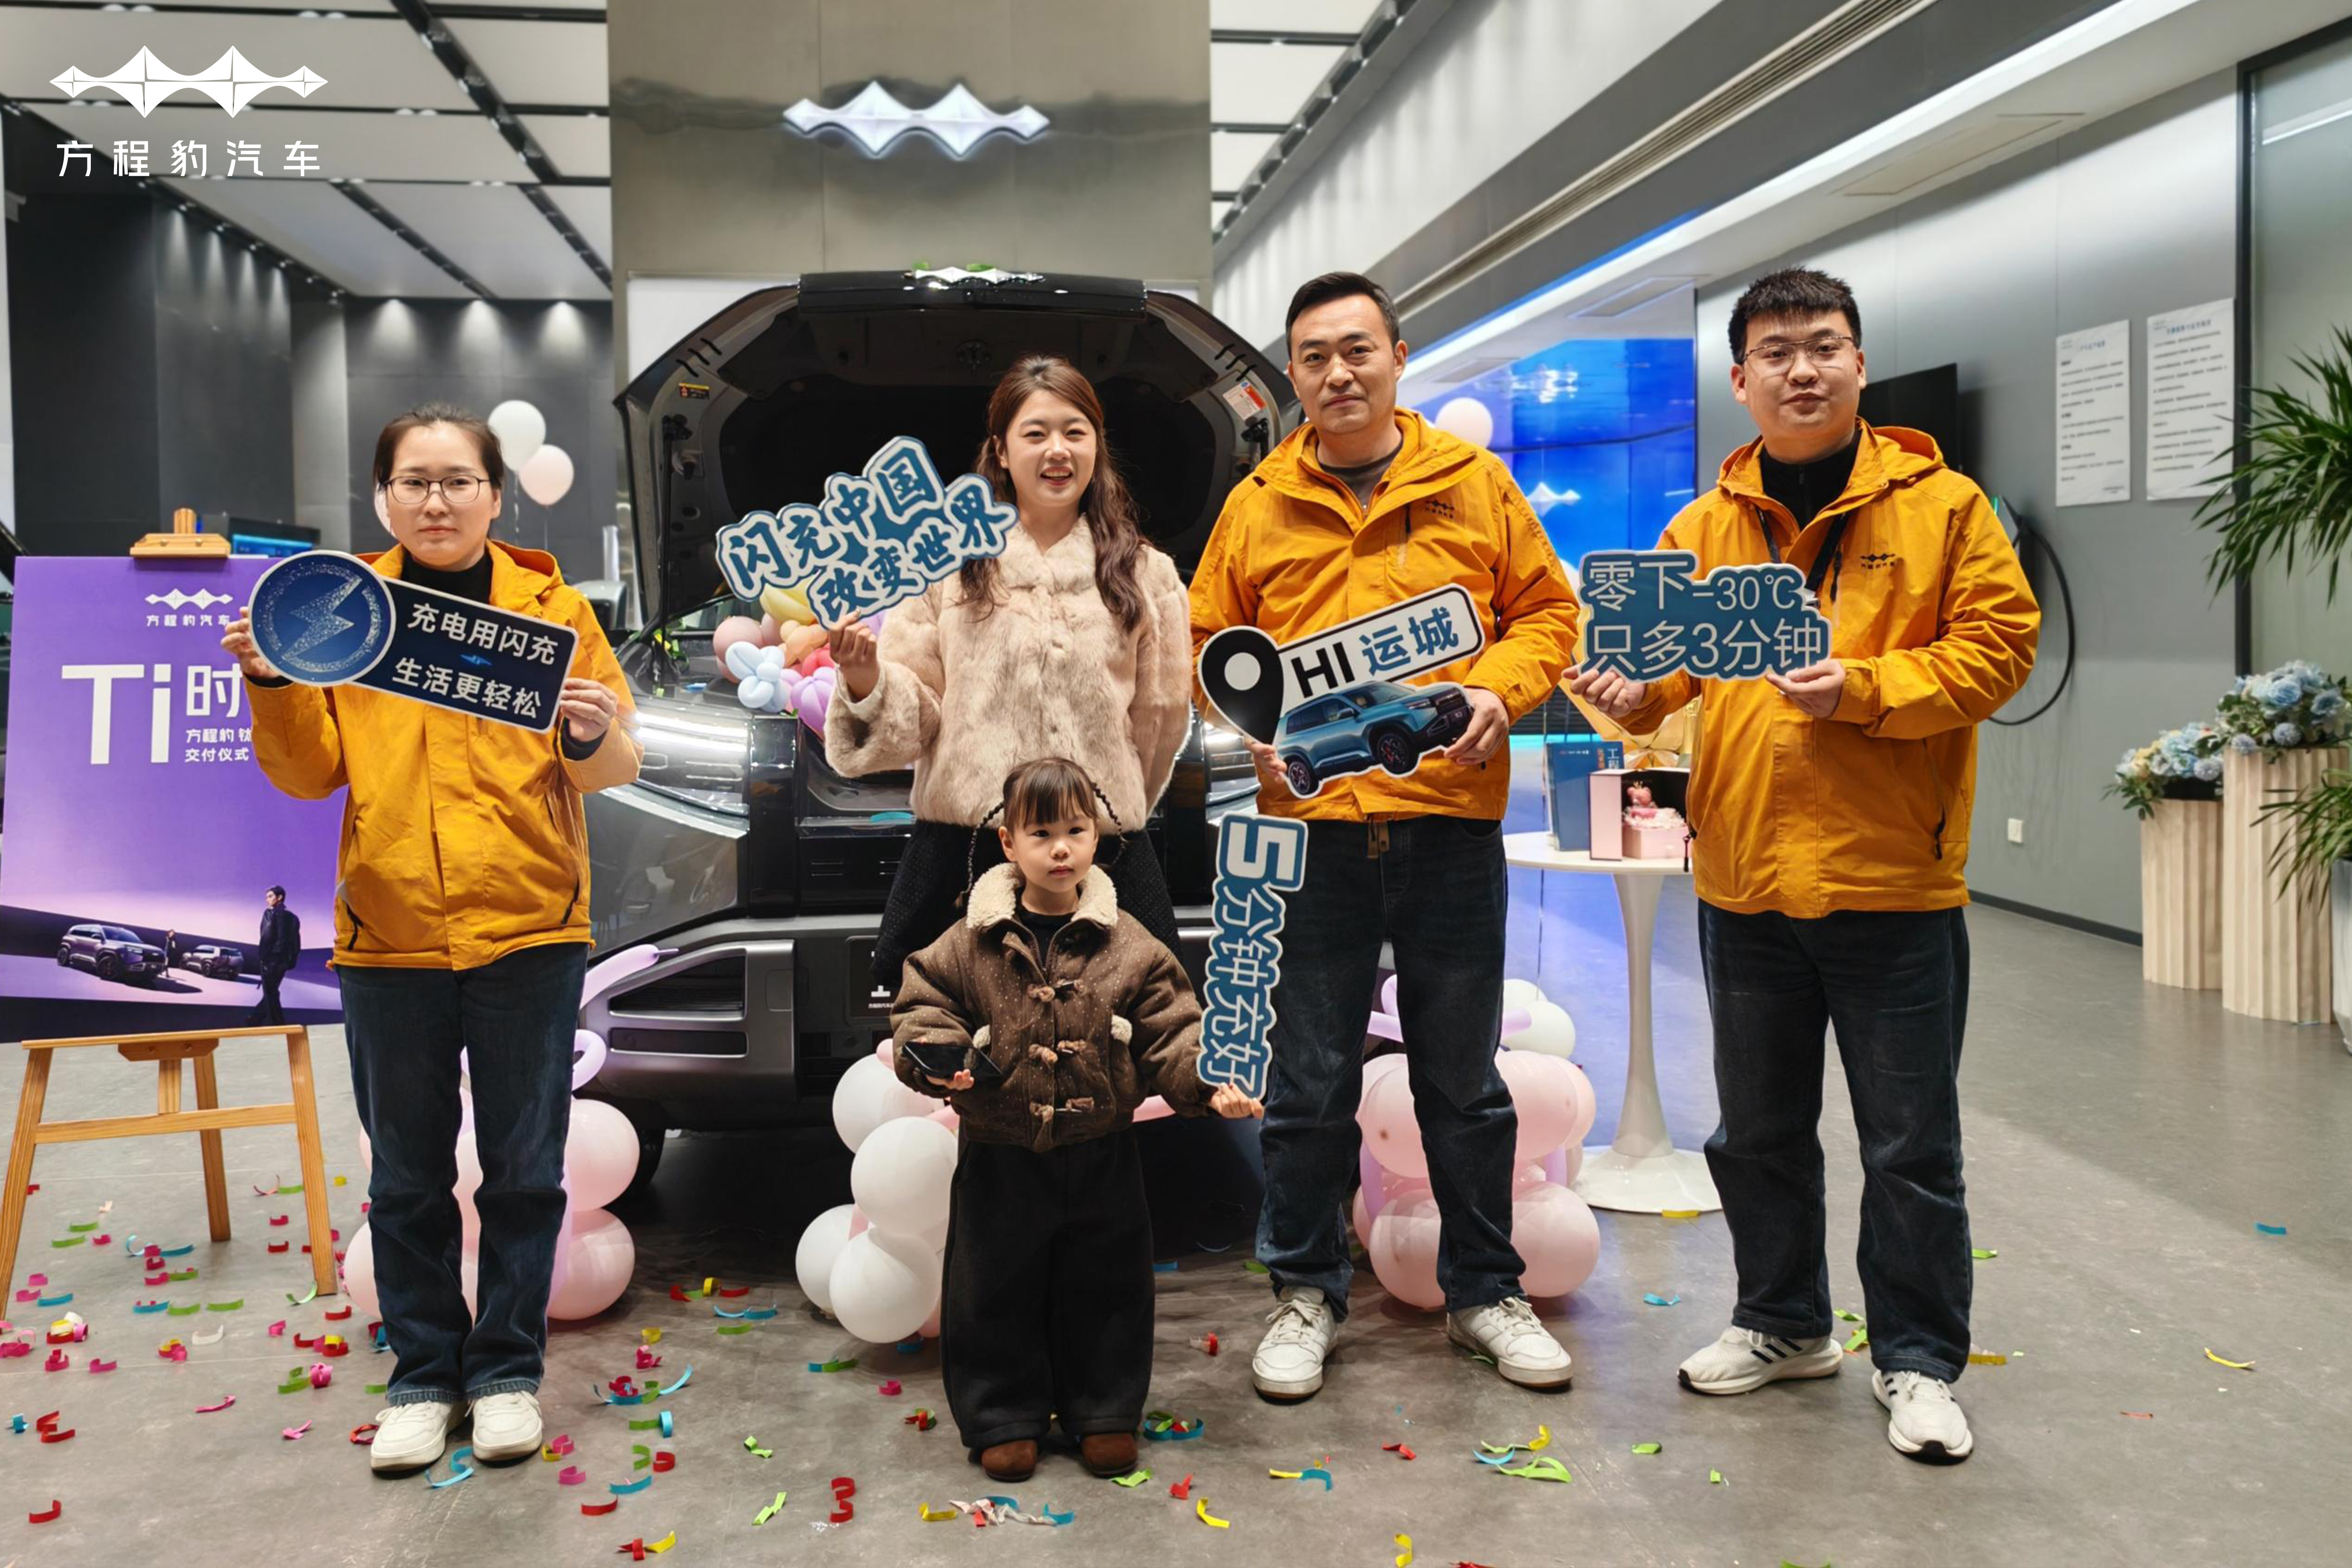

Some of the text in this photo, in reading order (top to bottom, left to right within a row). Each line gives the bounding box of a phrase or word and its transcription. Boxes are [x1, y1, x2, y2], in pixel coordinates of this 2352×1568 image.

[729, 446, 935, 590] 闪充中国
[818, 485, 1009, 621] 改变世界
[407, 602, 558, 665] 充电用闪充
[1291, 607, 1459, 698] HI 运城
[1594, 617, 1821, 674] 只多3分钟
[392, 657, 541, 718] 生活更轻松
[185, 747, 249, 762] 交付仪式
[1207, 822, 1298, 1091] 5分钟充好
